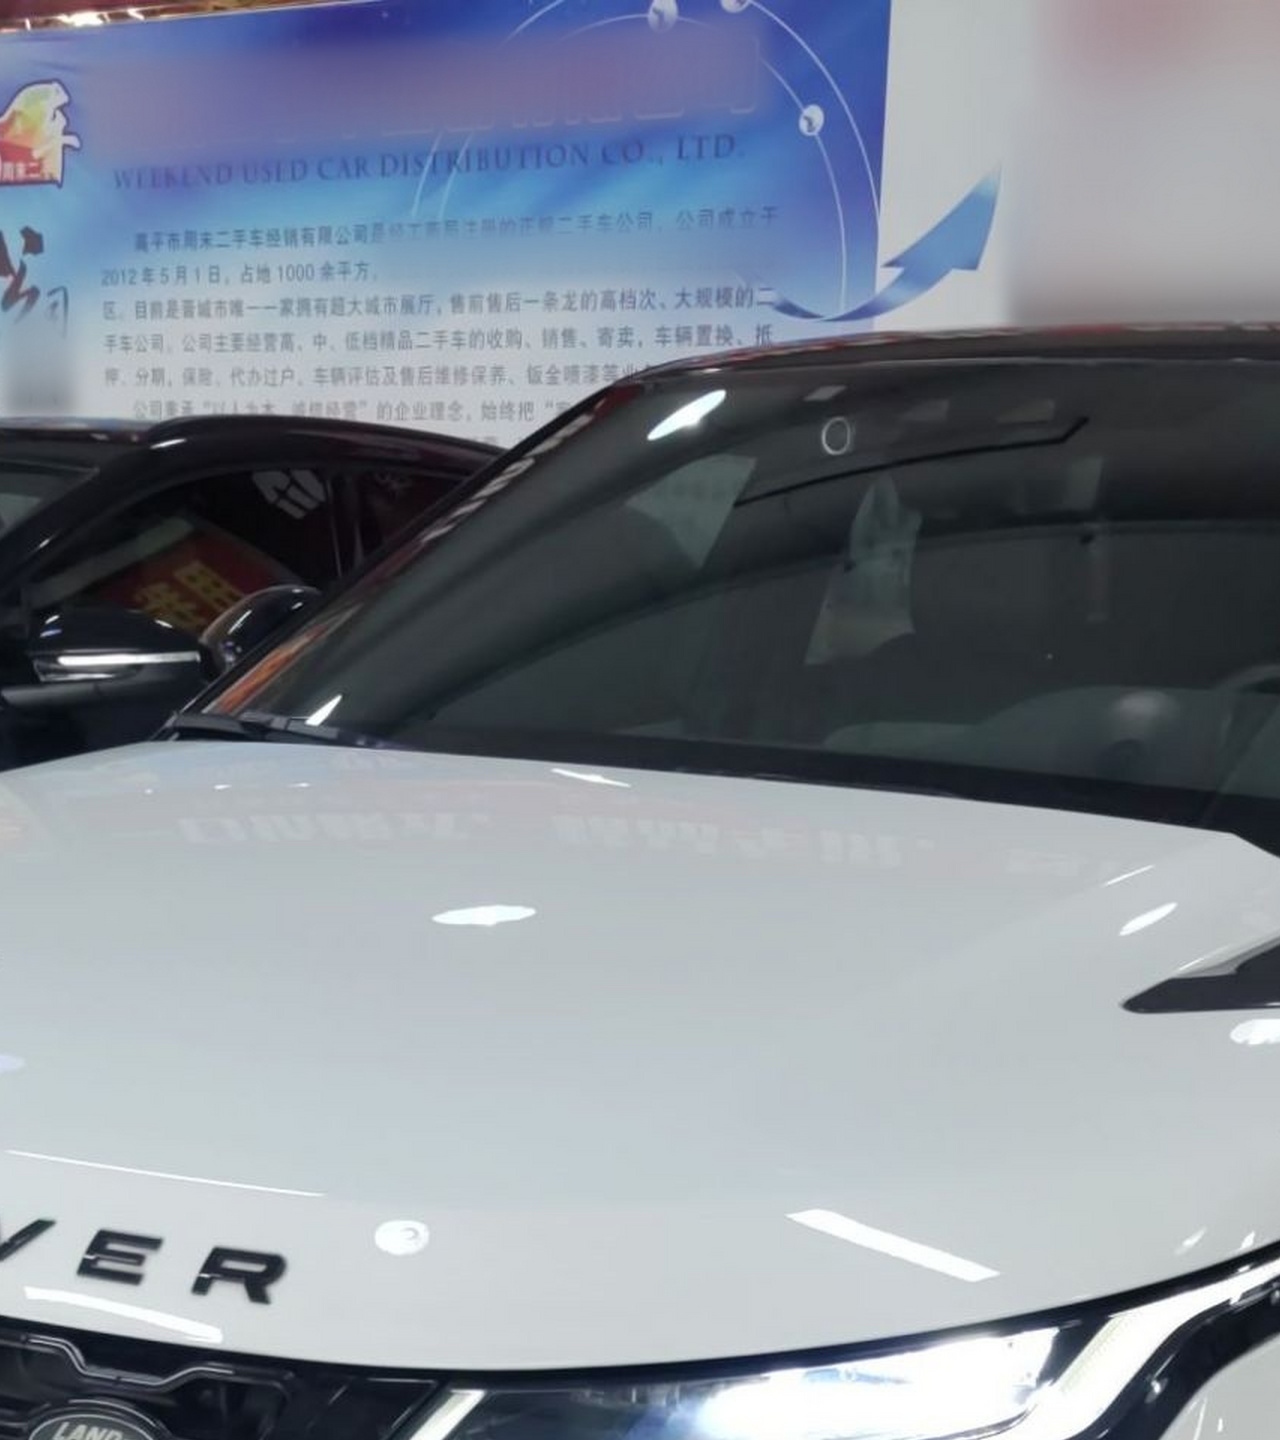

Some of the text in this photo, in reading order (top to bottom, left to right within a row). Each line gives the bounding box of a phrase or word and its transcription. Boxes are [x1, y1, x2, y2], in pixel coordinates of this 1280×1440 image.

[113, 161, 232, 190] WEEKEND
[243, 159, 308, 185] USED
[317, 157, 370, 181] CAR
[380, 142, 590, 178] DISTRIBUTION
[677, 134, 746, 161] LTD.
